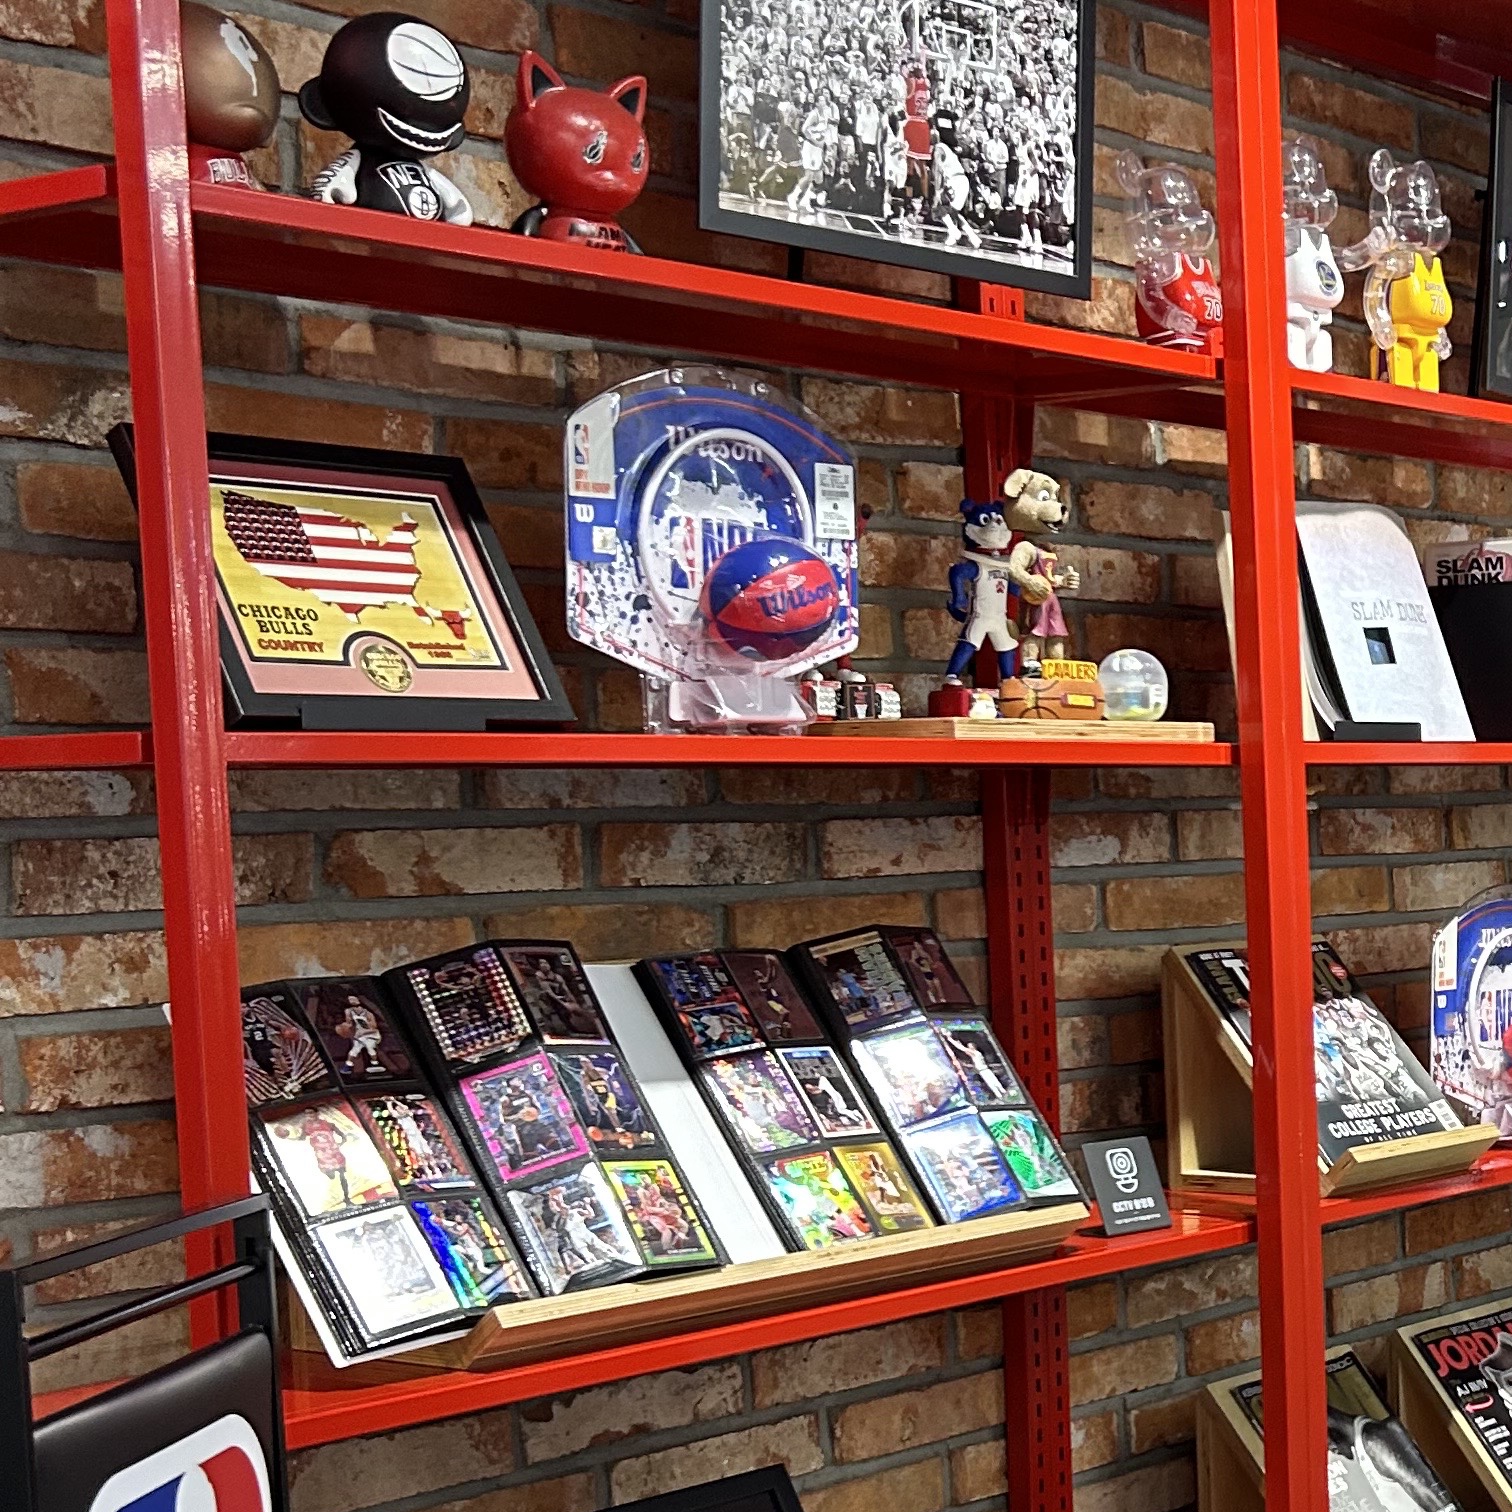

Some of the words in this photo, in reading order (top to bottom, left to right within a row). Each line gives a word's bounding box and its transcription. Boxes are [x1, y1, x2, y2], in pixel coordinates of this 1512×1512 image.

[1436, 556, 1504, 575] SLAM
[1437, 571, 1503, 588] DUNK
[237, 603, 320, 622] CHICAGO
[1350, 599, 1392, 623] SLAM
[256, 619, 314, 636] BULLS
[257, 637, 325, 653] COUNTRY
[1340, 1098, 1401, 1120] GREATEST
[1328, 1118, 1382, 1139] COLLEGE
[1380, 1106, 1437, 1131] PLAYERS
